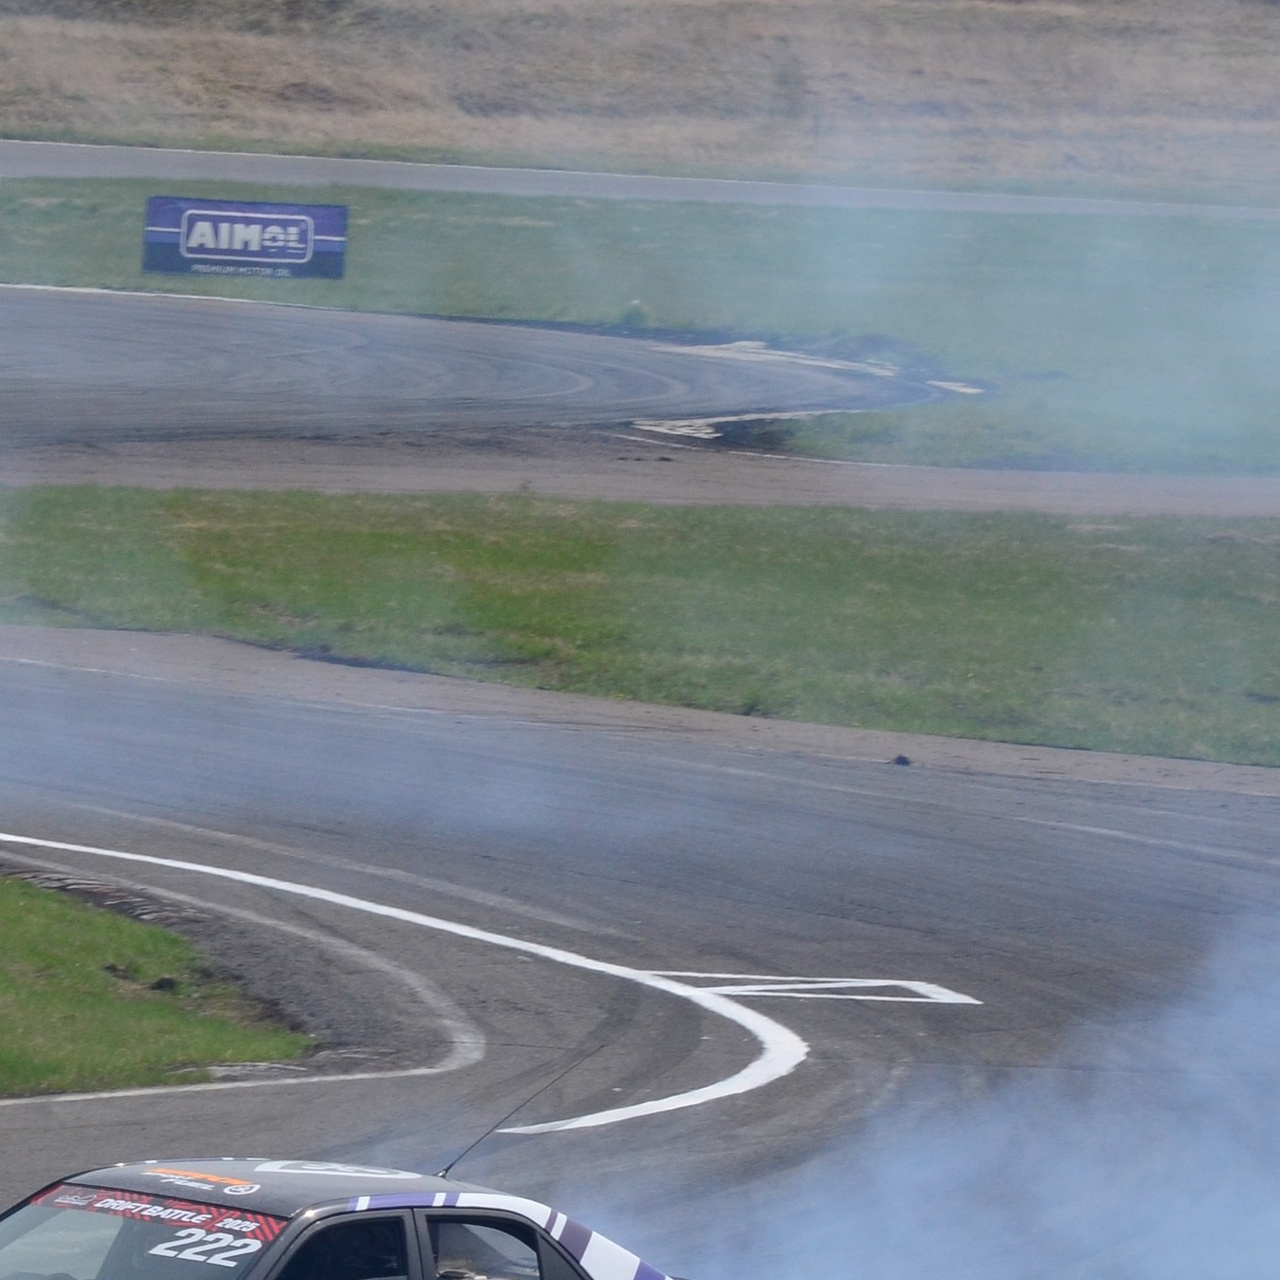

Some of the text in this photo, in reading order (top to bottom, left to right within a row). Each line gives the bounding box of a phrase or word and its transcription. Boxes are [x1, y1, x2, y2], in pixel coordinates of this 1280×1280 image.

[187, 221, 306, 252] AIMOL
[94, 1198, 144, 1214] DRIFT
[141, 1203, 213, 1224] BATTLE
[215, 1218, 261, 1232] 2025
[148, 1227, 263, 1268] 222
